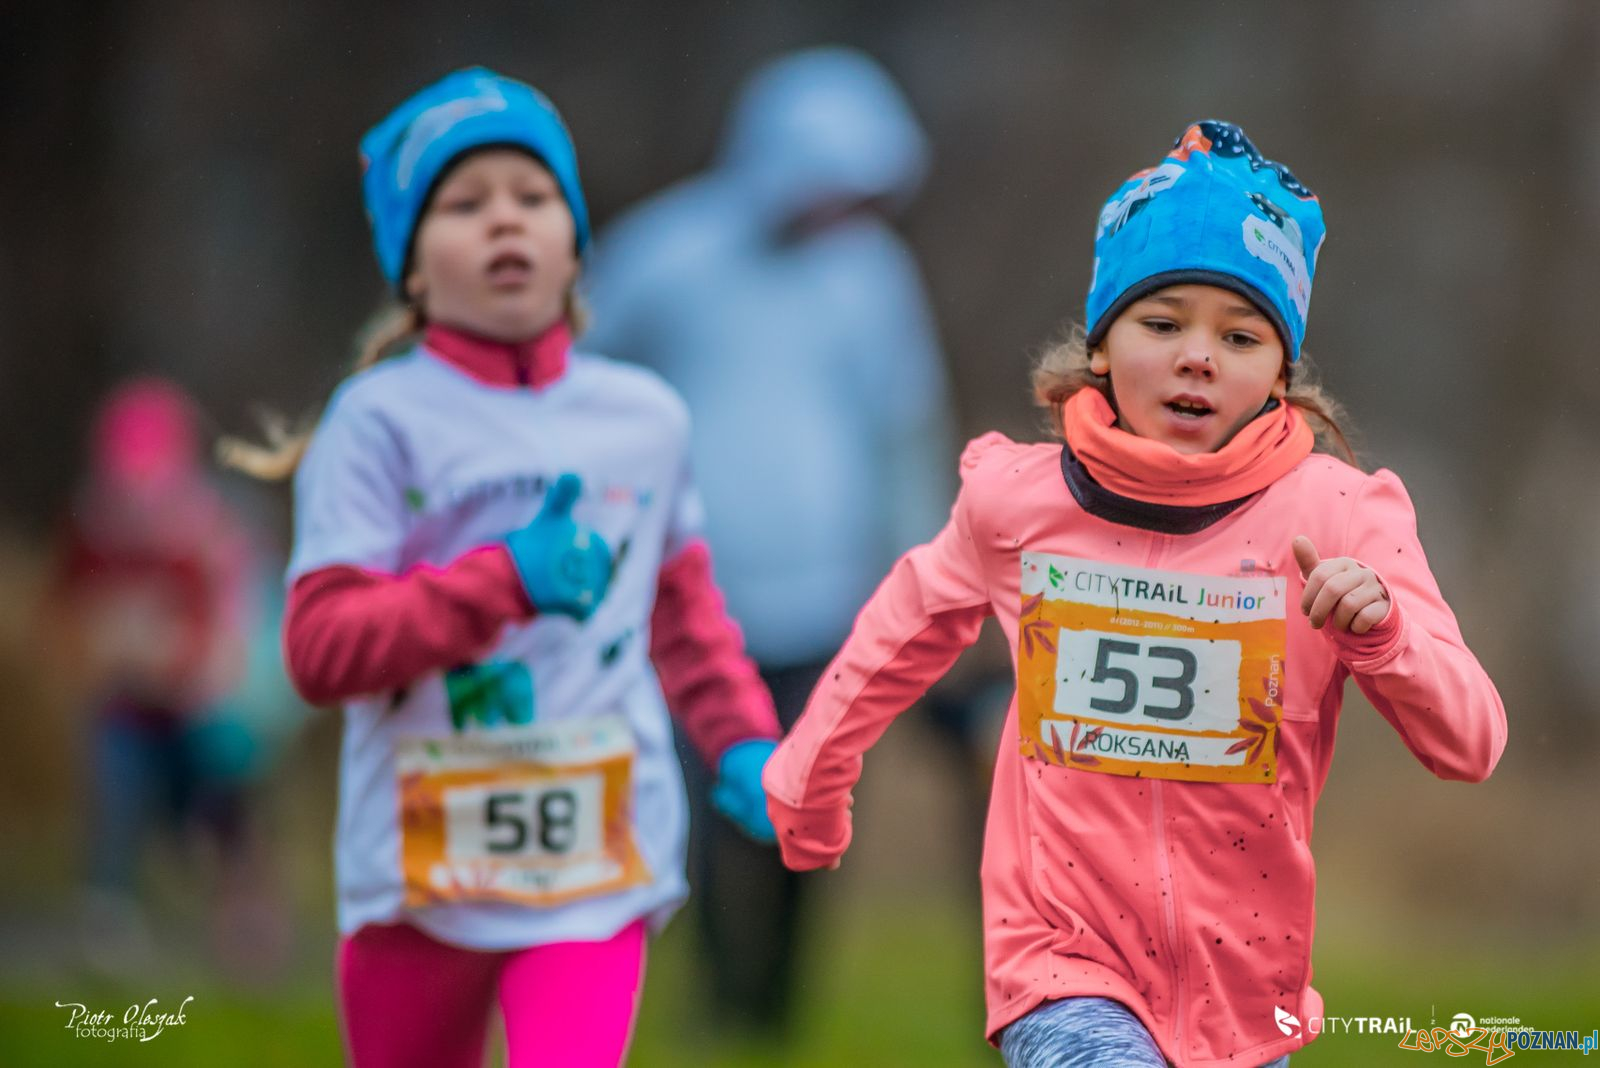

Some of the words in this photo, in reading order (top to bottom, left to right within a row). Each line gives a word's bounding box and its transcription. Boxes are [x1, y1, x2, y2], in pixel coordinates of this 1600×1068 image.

[1197, 587, 1266, 610] Junior
[1089, 637, 1199, 721] 53
[1084, 730, 1190, 760] ROKSANA
[485, 789, 578, 855] 58
